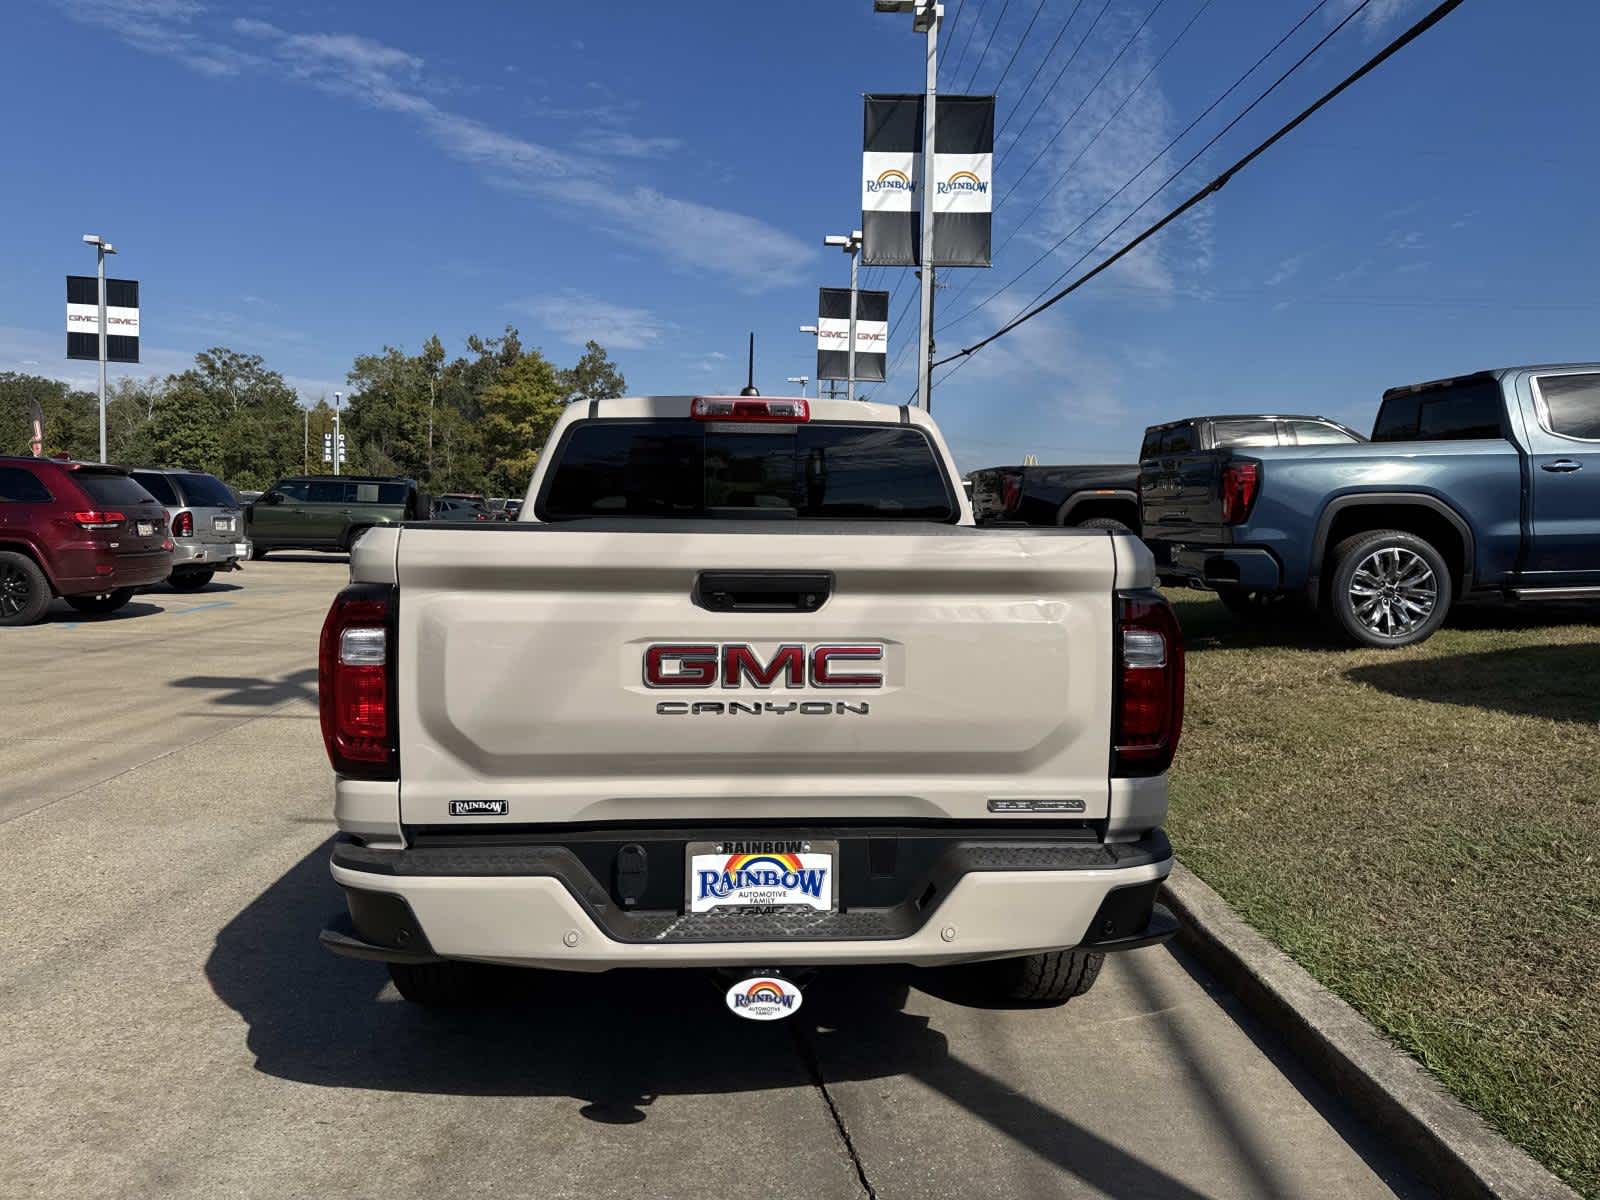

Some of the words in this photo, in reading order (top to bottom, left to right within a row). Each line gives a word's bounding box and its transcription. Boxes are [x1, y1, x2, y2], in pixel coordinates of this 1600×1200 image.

[866, 180, 918, 193] RAINBOW
[937, 181, 989, 195] RAINBOW
[68, 314, 99, 323] GMC
[108, 316, 138, 326] GMC
[820, 330, 849, 339] GMC
[857, 332, 886, 341] GMC
[642, 642, 885, 690] GMC
[655, 701, 870, 716] CANYON
[455, 801, 503, 814] RAINBOW
[723, 840, 803, 854] RAINBOW
[697, 868, 828, 902] RAINBOW
[738, 890, 788, 898] AUTOMOTIVE
[734, 993, 796, 1009] RAINBOW
